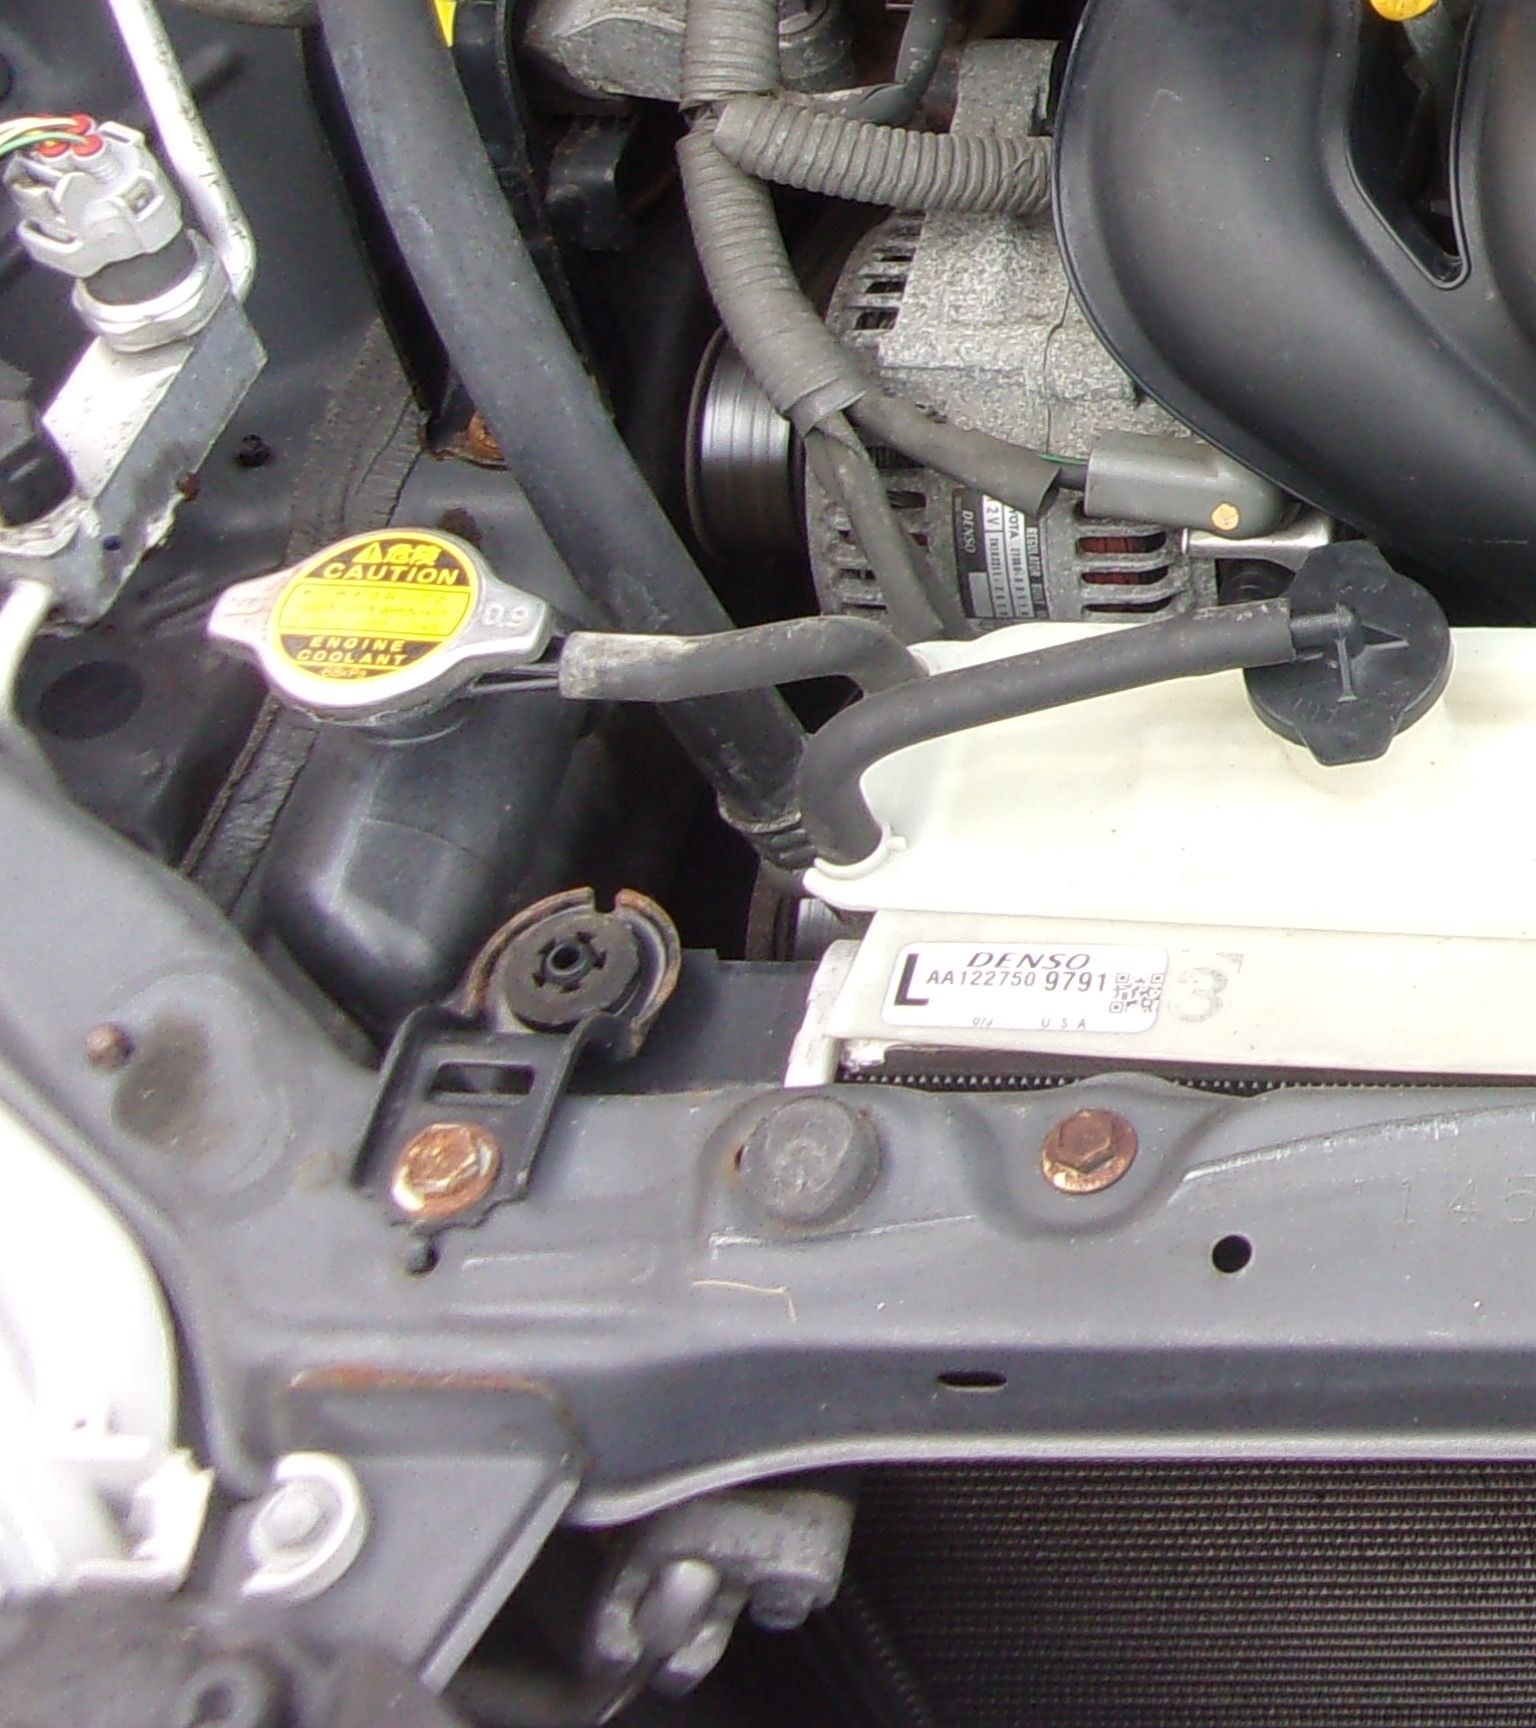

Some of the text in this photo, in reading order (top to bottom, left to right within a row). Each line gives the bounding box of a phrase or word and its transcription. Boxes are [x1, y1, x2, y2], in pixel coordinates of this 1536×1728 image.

[962, 509, 977, 554] DENSO
[322, 560, 460, 587] CAUTION
[483, 601, 532, 630] 0.9
[308, 635, 406, 653] ENGINE
[296, 648, 408, 667] COOLANT
[966, 951, 1093, 971] DENSO
[893, 952, 930, 1008] L
[926, 969, 1108, 993] AA122750 9791
